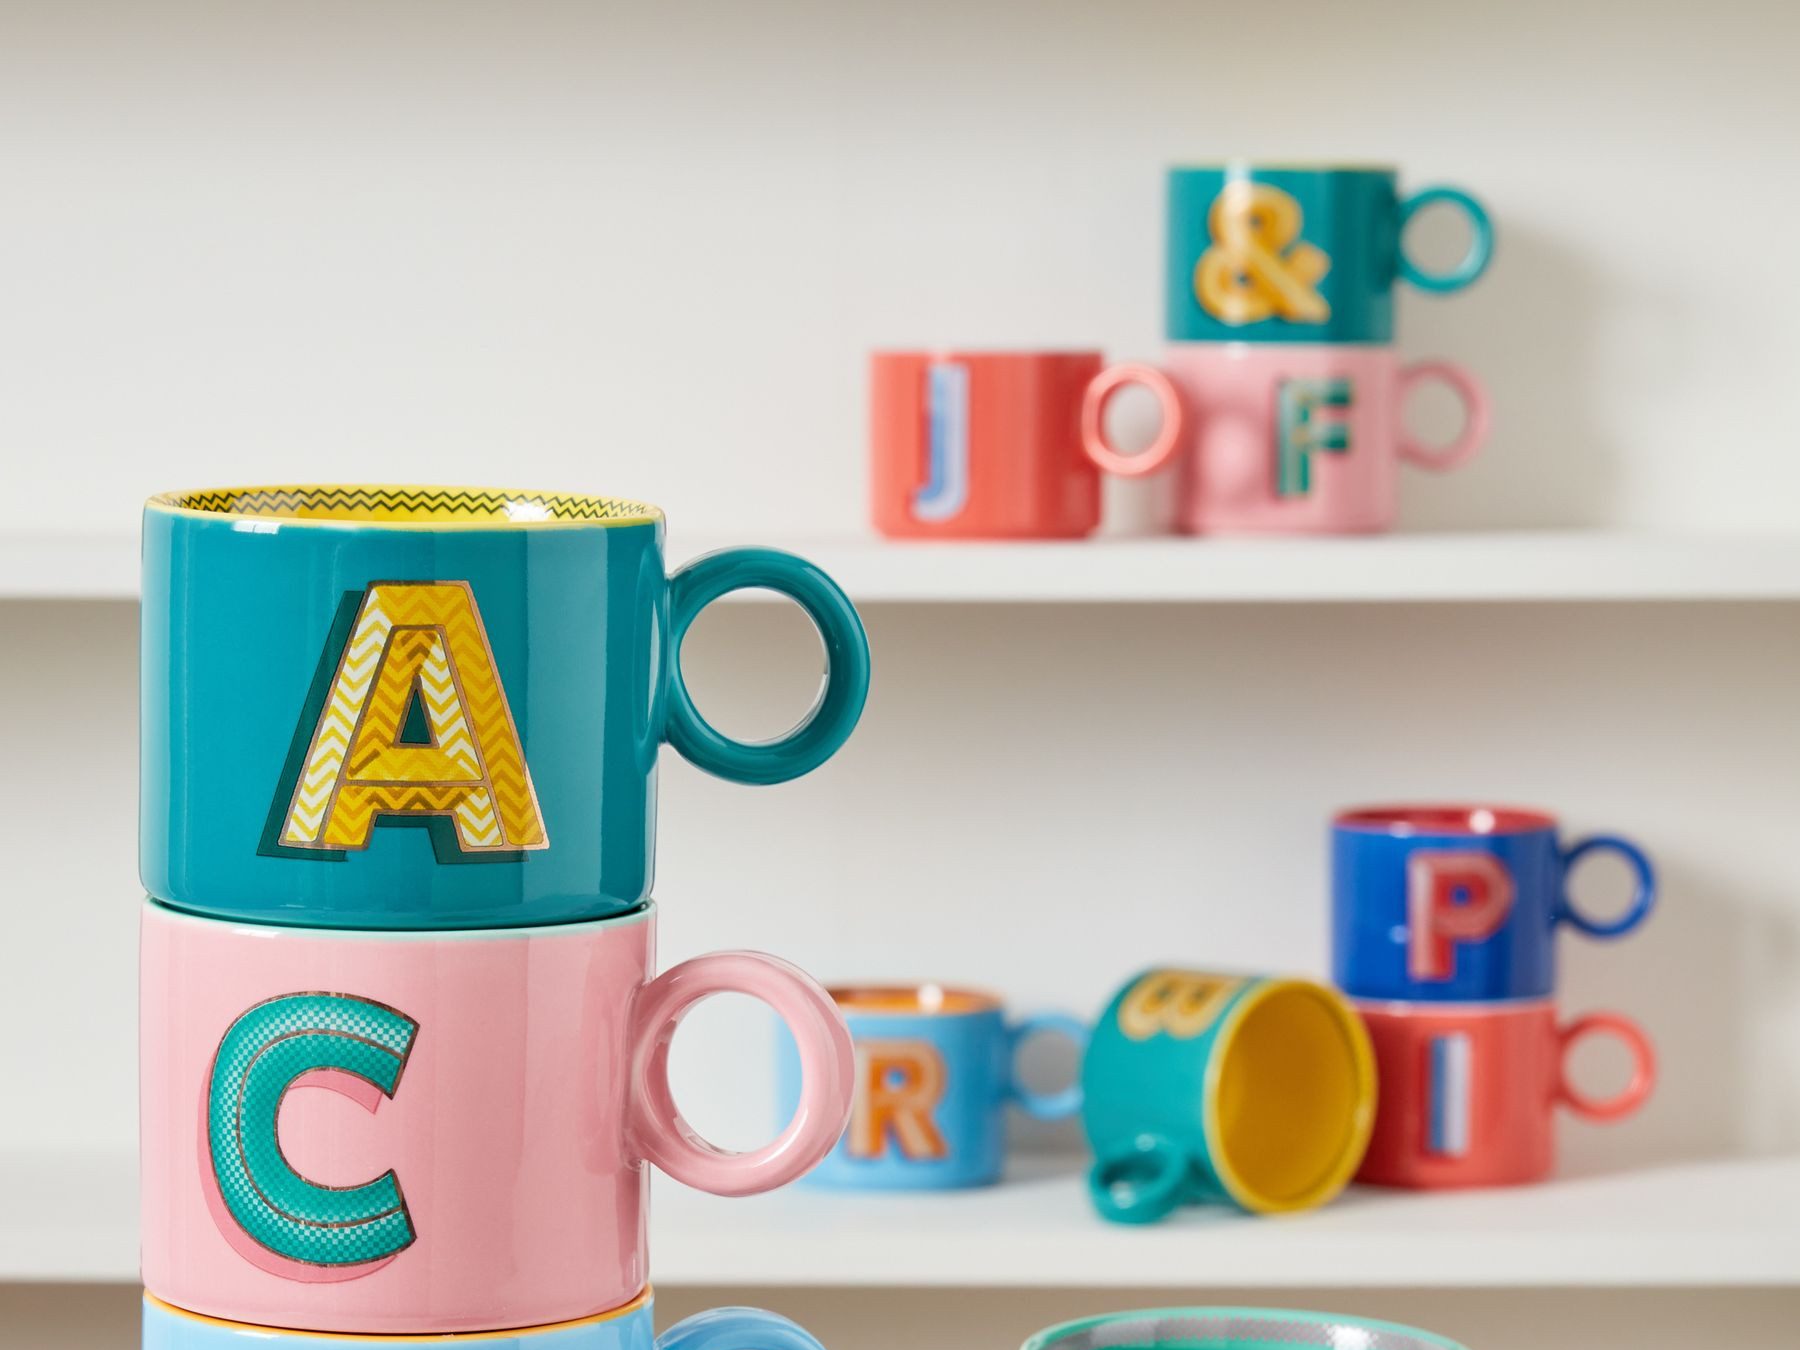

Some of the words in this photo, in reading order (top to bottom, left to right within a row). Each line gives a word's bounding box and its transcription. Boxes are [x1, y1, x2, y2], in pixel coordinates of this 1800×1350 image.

[1194, 182, 1332, 325] &
[910, 360, 970, 521] J
[1276, 377, 1353, 498] F
[276, 579, 550, 853] A
[1407, 850, 1515, 982] P
[206, 990, 421, 1268] C
[848, 1039, 949, 1160] R
